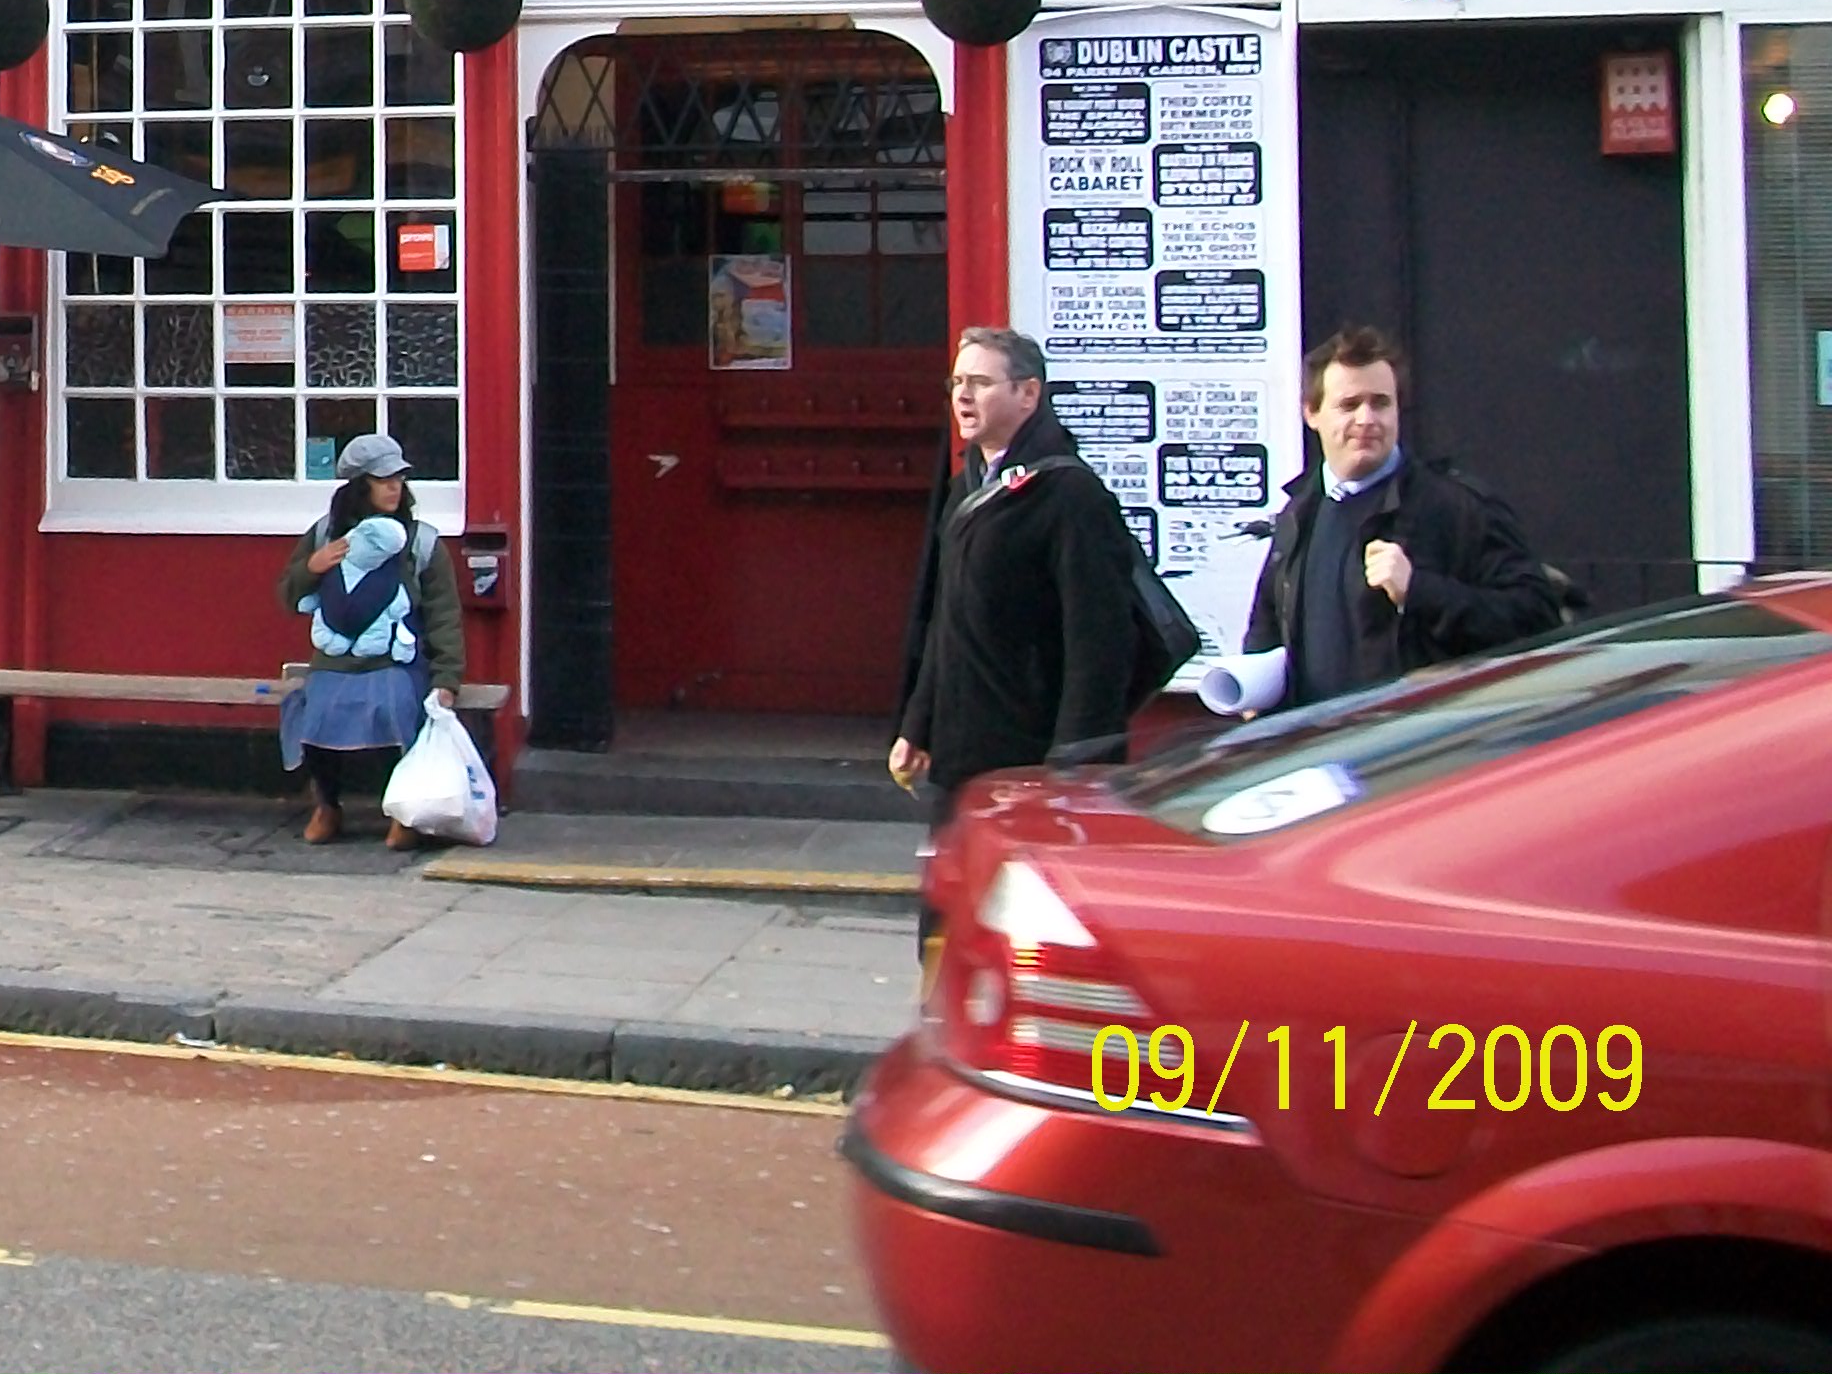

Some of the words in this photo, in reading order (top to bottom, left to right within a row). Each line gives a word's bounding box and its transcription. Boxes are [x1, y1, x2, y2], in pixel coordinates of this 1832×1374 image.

[1077, 39, 1164, 65] DUBLIN
[1168, 37, 1260, 63] CASTLE
[1160, 96, 1198, 107] THIRD
[1202, 95, 1253, 106] CORTEZ
[1160, 109, 1253, 118] FEMMEPOP
[1049, 156, 1086, 174] ROCK
[1111, 156, 1144, 173] ROLL
[1050, 176, 1145, 191] CABARET
[1159, 182, 1253, 195] STOREY
[1162, 222, 1195, 232] THE
[1208, 243, 1257, 252] GHOST
[1077, 286, 1098, 298] LIFE
[1053, 313, 1104, 321] GIANT
[1111, 312, 1147, 321] PAW
[1053, 323, 1148, 331] MUNICH
[1164, 472, 1262, 486] NYLO
